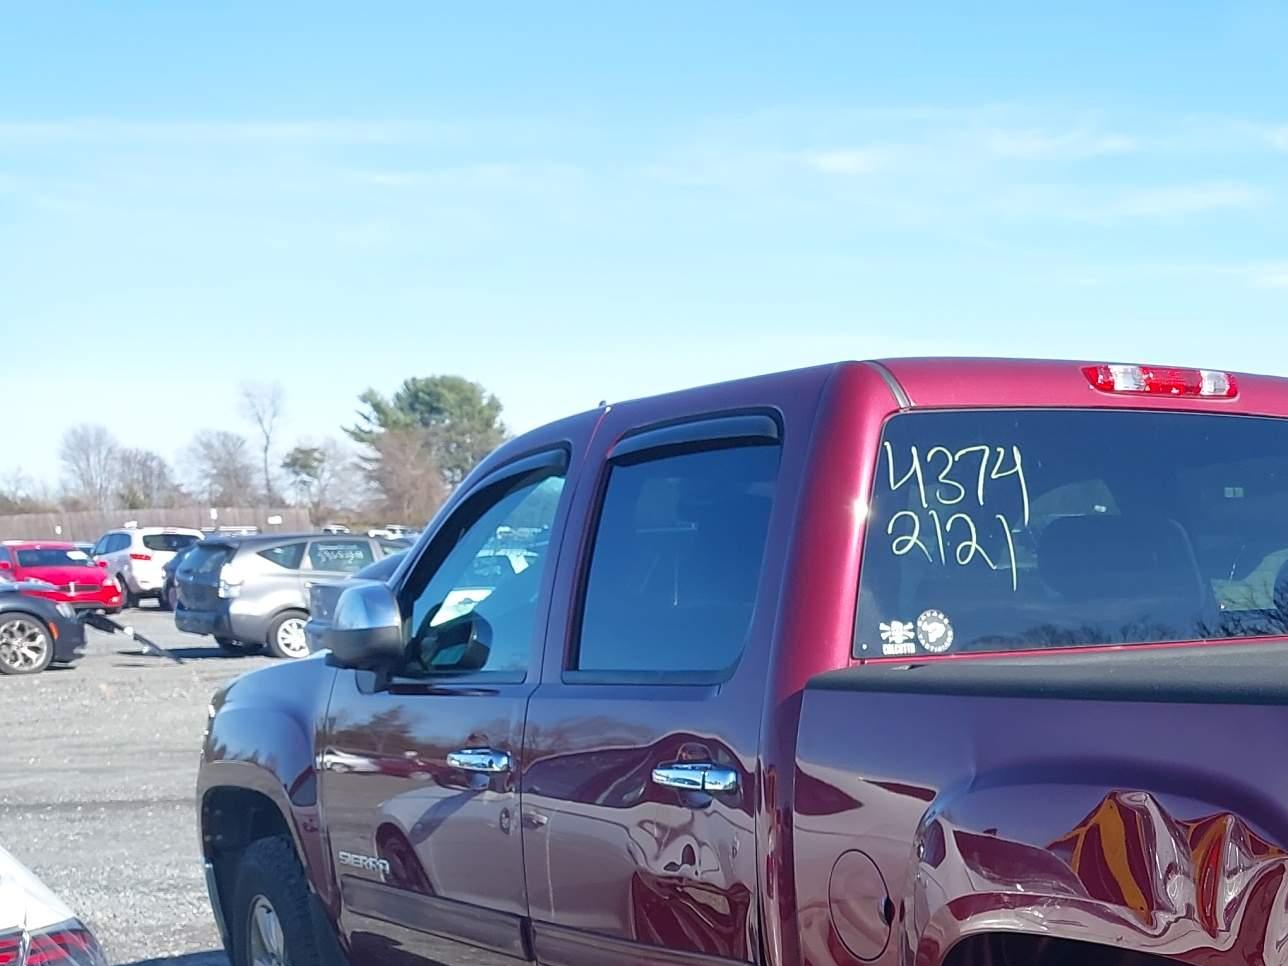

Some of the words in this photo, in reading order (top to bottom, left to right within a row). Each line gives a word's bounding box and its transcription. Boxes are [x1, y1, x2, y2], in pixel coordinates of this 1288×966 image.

[884, 441, 1029, 527] 4374
[887, 510, 1017, 592] 2121
[338, 851, 390, 875] SIERRA
